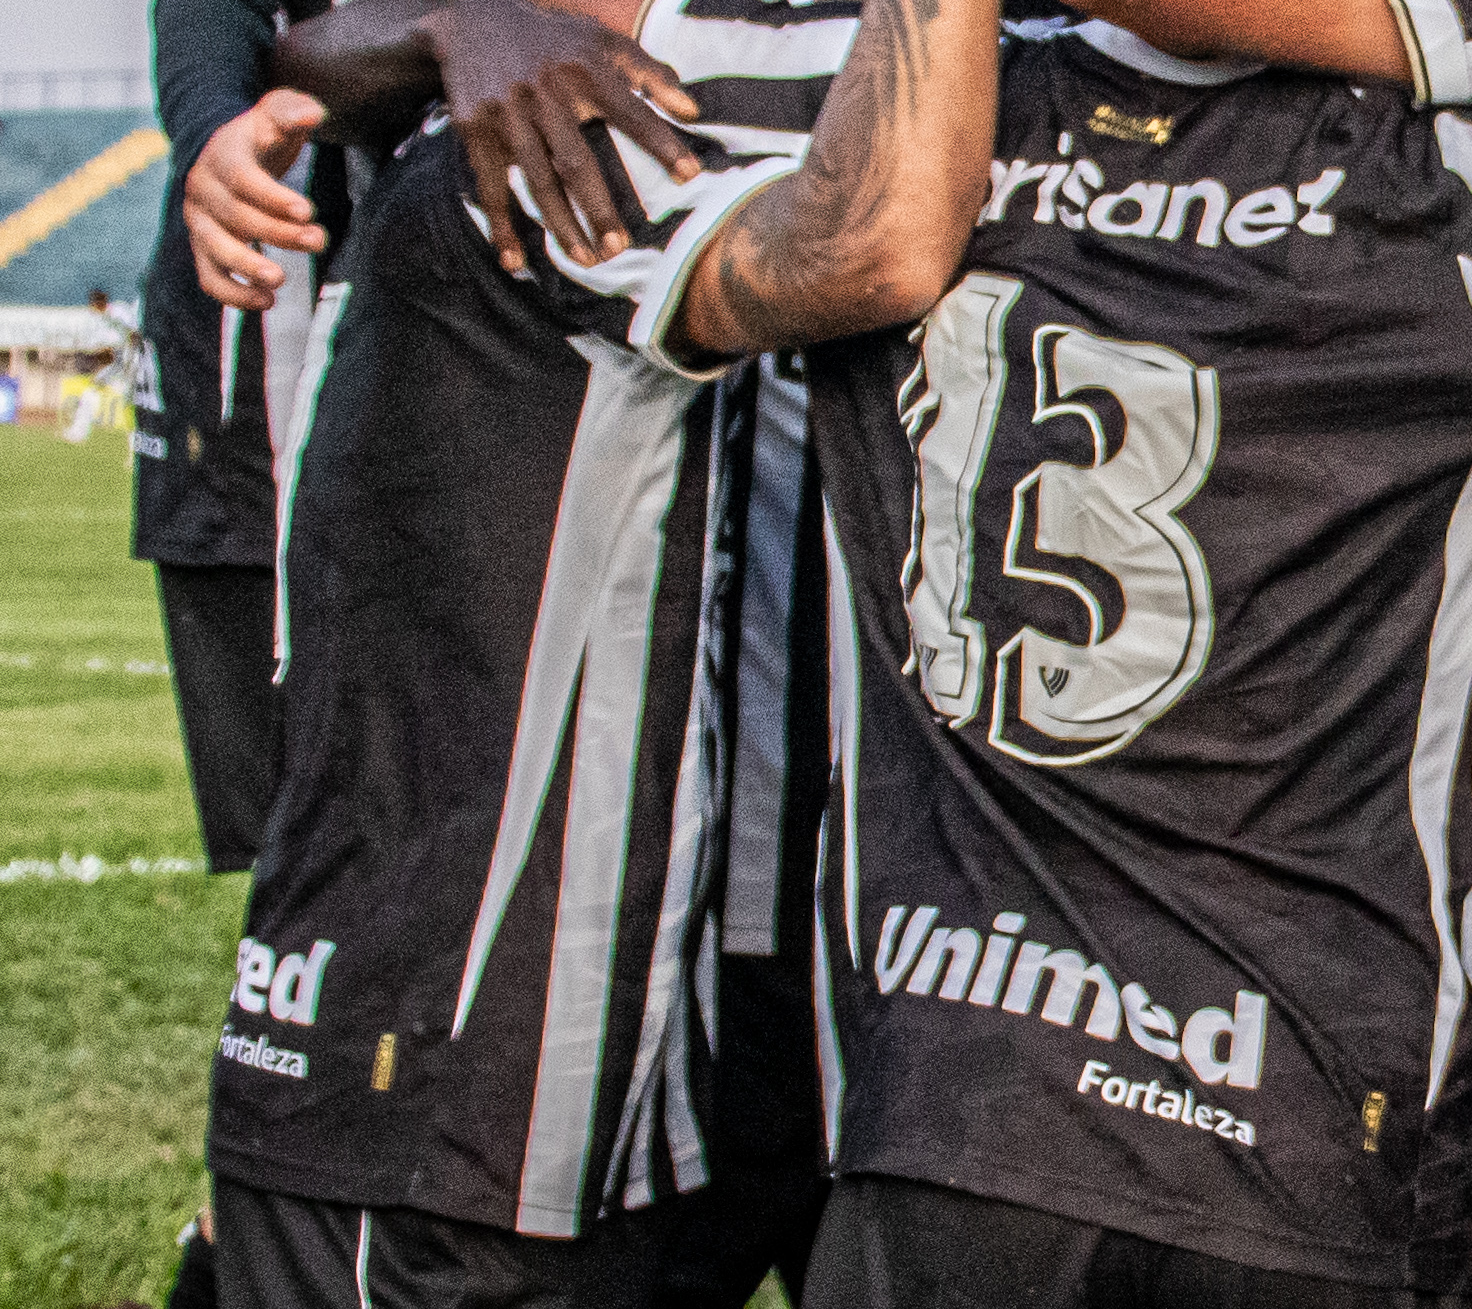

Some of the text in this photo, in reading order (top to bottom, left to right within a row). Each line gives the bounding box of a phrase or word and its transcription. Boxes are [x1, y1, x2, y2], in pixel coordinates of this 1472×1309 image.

[982, 132, 1345, 249] risanet
[898, 273, 1220, 766] 13
[873, 904, 1270, 1090] Unimed
[1077, 1060, 1258, 1148] Fortaleza
